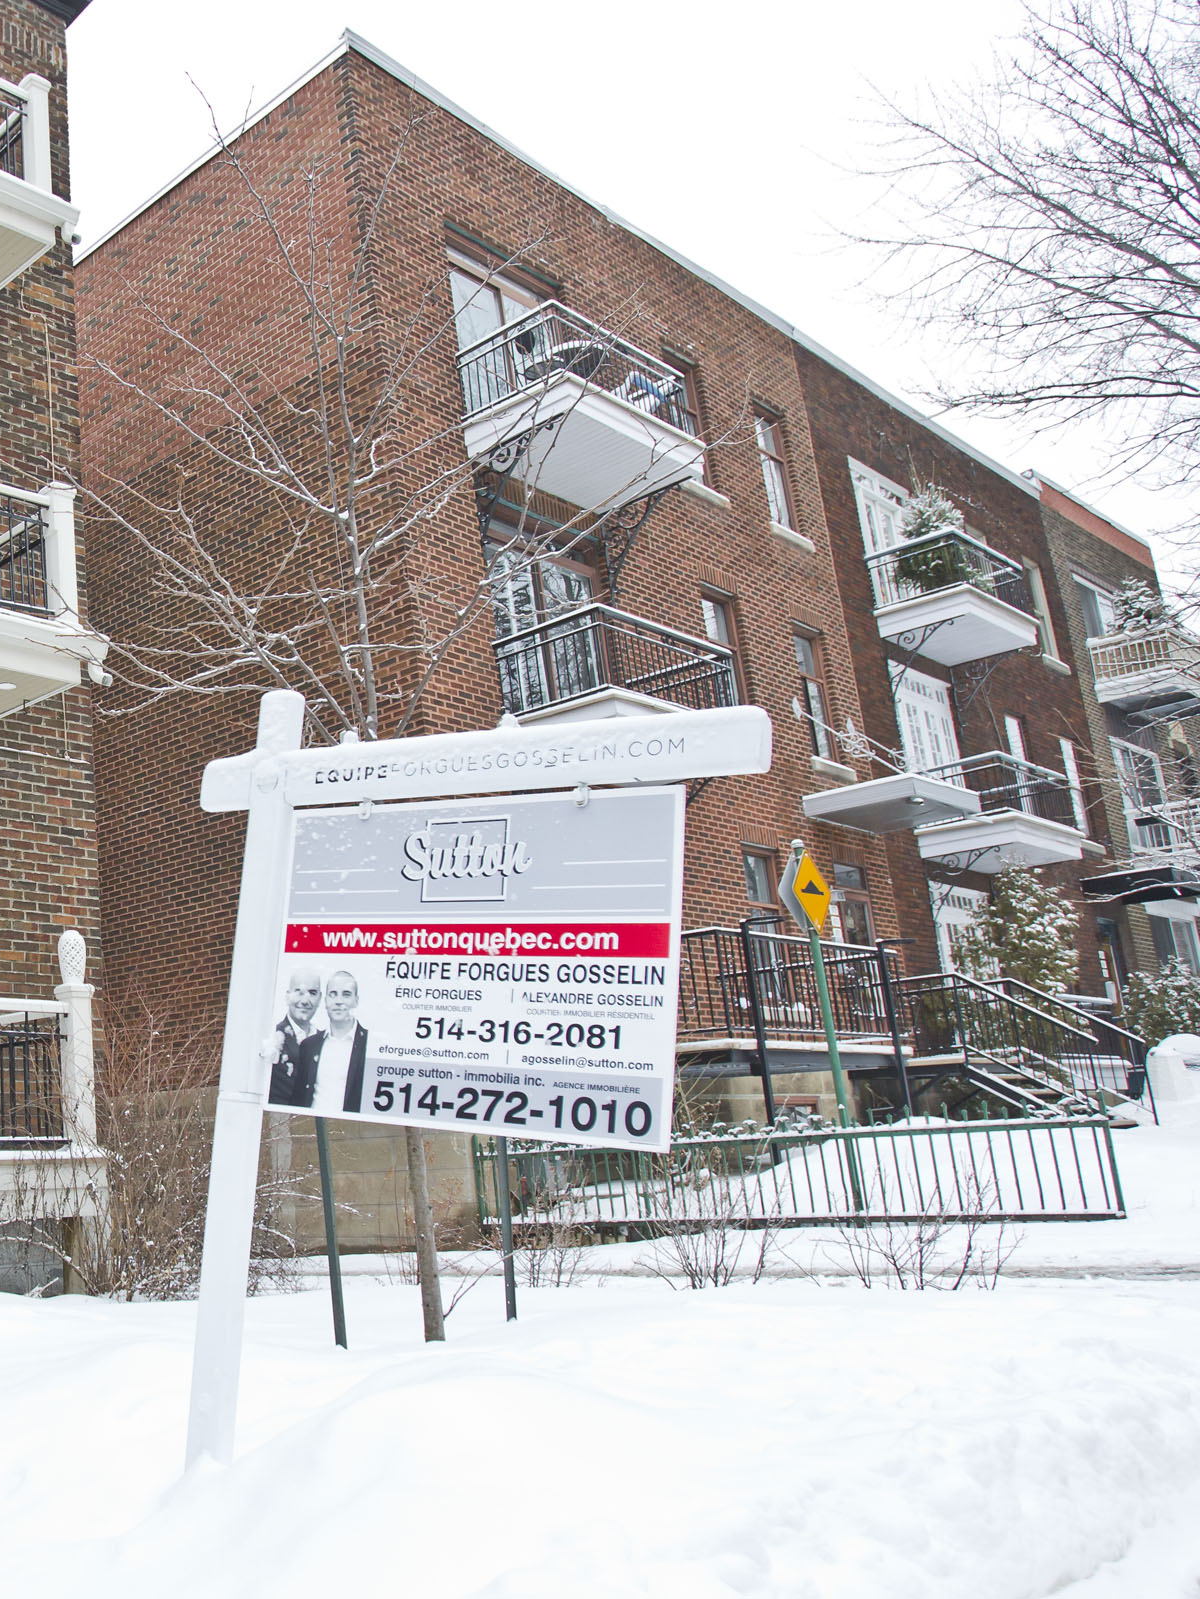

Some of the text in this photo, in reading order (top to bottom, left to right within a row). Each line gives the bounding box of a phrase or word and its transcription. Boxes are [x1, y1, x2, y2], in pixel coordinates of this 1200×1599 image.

[401, 830, 532, 881] Sutton
[323, 927, 619, 953] www.suttonquebec.com
[385, 956, 666, 986] ÉQUIPE FORGUES GOSSELIN
[395, 985, 482, 1001] ÉRIC FORGUES
[522, 991, 664, 1008] ALEXANDRE GOSSELIN
[402, 1002, 473, 1013] COURTIER IMMOBILIER
[563, 1009, 606, 1018] IMMOBILIER
[414, 1016, 622, 1050] 514-316-2081
[378, 1044, 490, 1061] eforgues@sutton.com
[521, 1053, 654, 1072] agosselin@sutton.com
[376, 1064, 415, 1079] groupe
[418, 1066, 453, 1080] sutton
[464, 1069, 520, 1086] immobilia
[523, 1073, 545, 1088] inc.
[552, 1081, 641, 1095] AGENCE IMMOBILIÈRE
[372, 1079, 653, 1137] 514-272-1010
